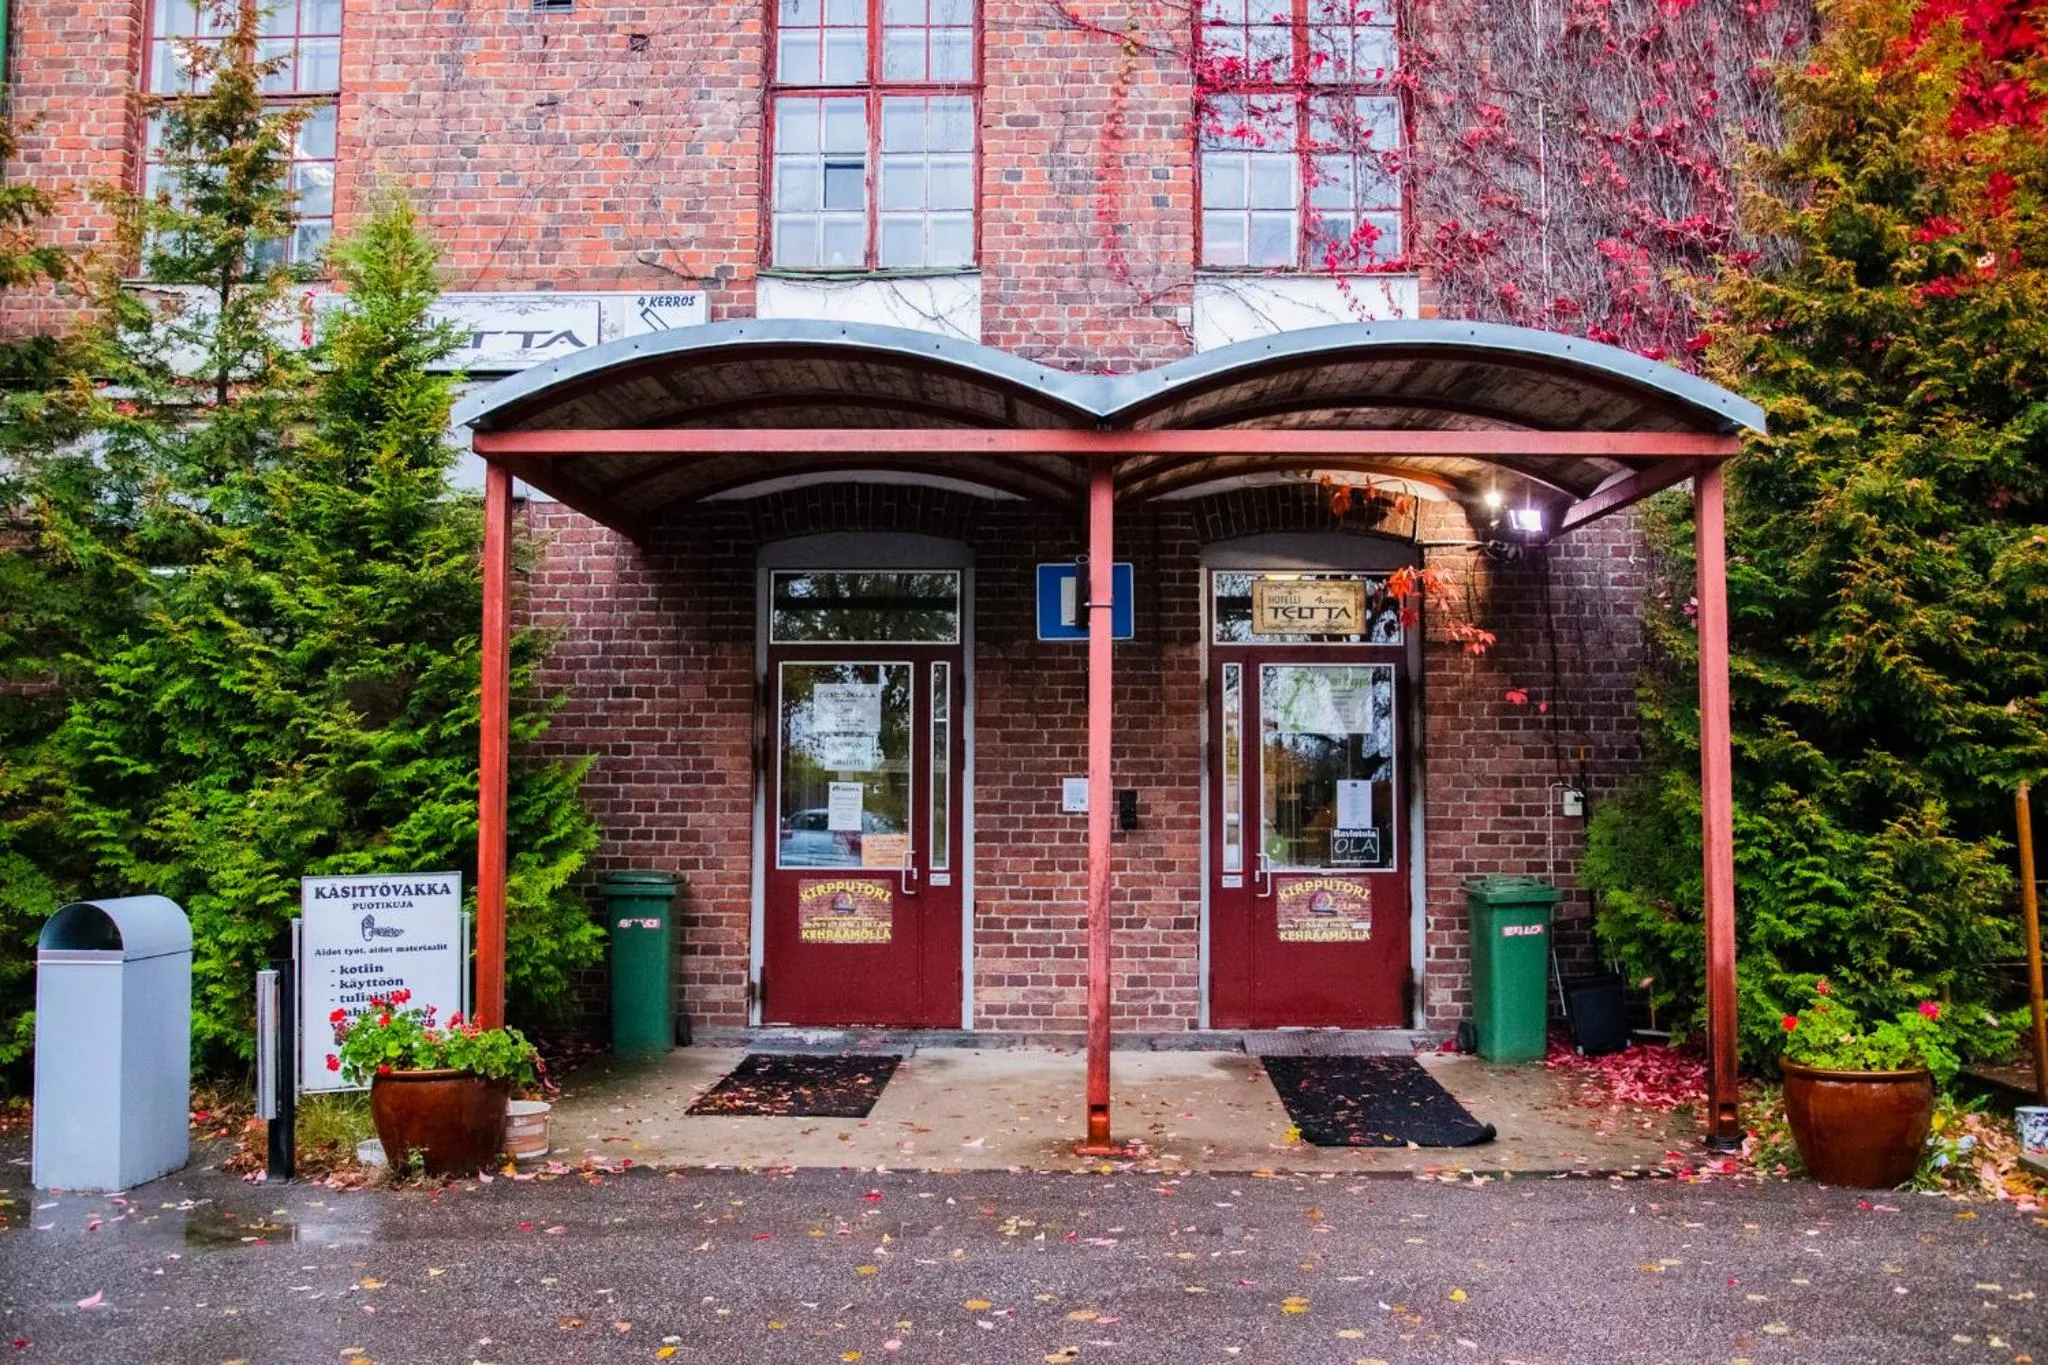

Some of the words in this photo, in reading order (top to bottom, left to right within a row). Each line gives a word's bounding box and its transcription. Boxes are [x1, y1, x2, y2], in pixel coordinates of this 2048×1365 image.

[637, 296, 646, 308] 4
[650, 295, 696, 308] KERROS
[1334, 838, 1377, 854] OLA
[314, 882, 452, 900] KÄSITYÖVAKKA
[800, 881, 893, 903] KIRPPUTORI
[1278, 879, 1372, 901] KIRPPUTORI
[352, 900, 414, 911] PUOTIKUJA
[339, 963, 384, 975] kotiin
[339, 977, 404, 990] käyttöön
